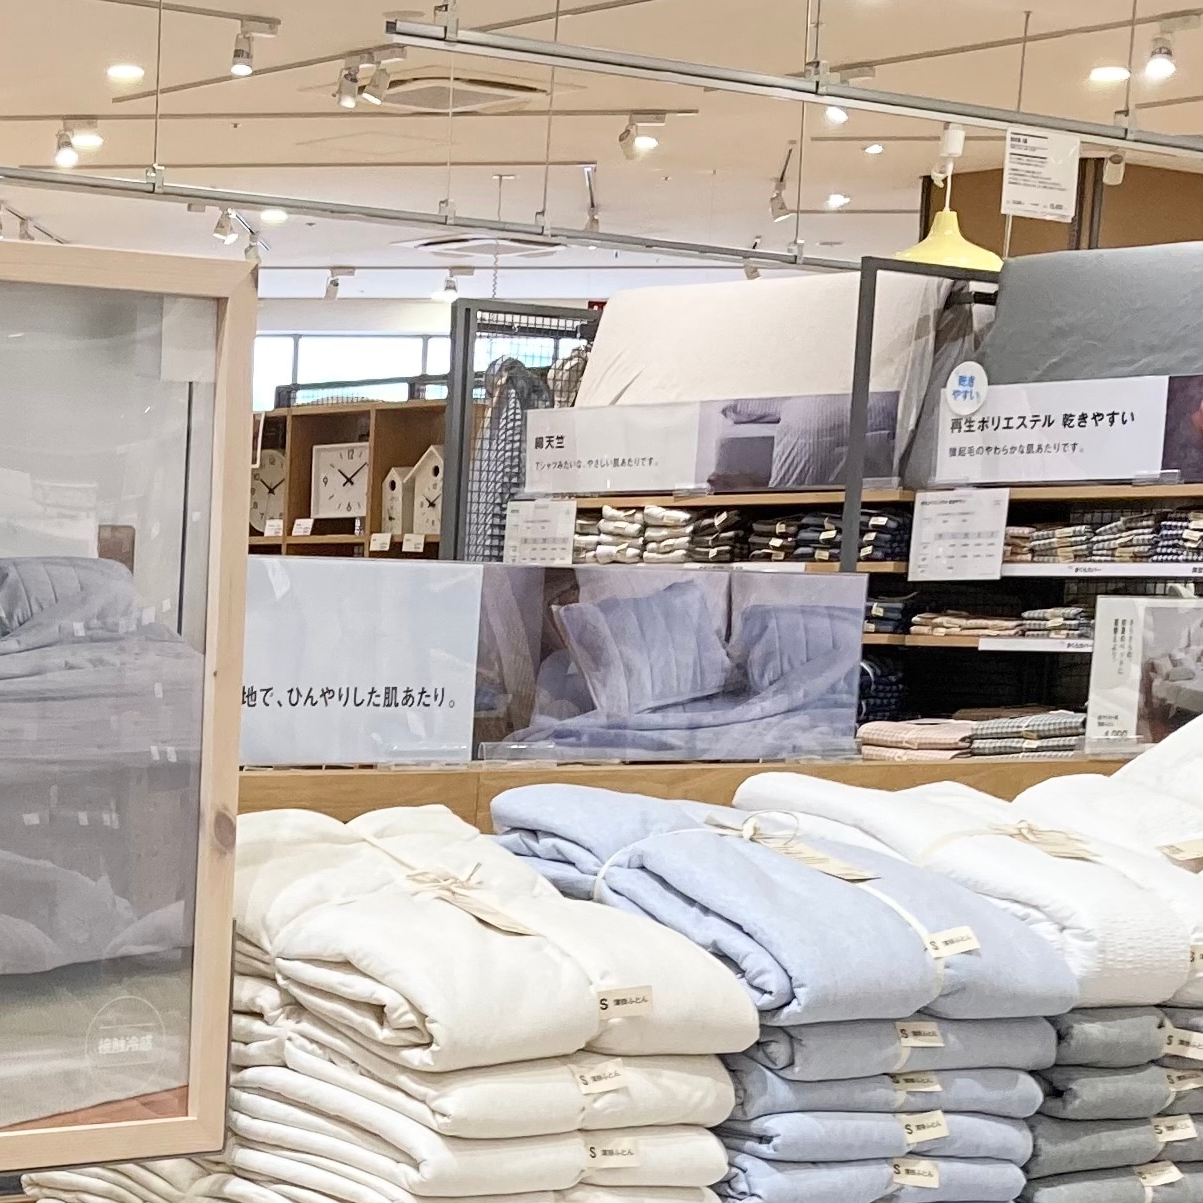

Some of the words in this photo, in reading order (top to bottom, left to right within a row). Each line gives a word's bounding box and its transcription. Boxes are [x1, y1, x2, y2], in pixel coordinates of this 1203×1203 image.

[950, 413, 1054, 434] 再生ポリエステル
[1061, 410, 1135, 429] 乾きやすい
[241, 686, 455, 708] 地で、ひんやりした肌あたり。
[600, 998, 608, 1010] S
[900, 1029, 909, 1039] S
[579, 1074, 589, 1086] S
[905, 1124, 914, 1135] S
[589, 1147, 597, 1158] S
[893, 1164, 901, 1175] S
